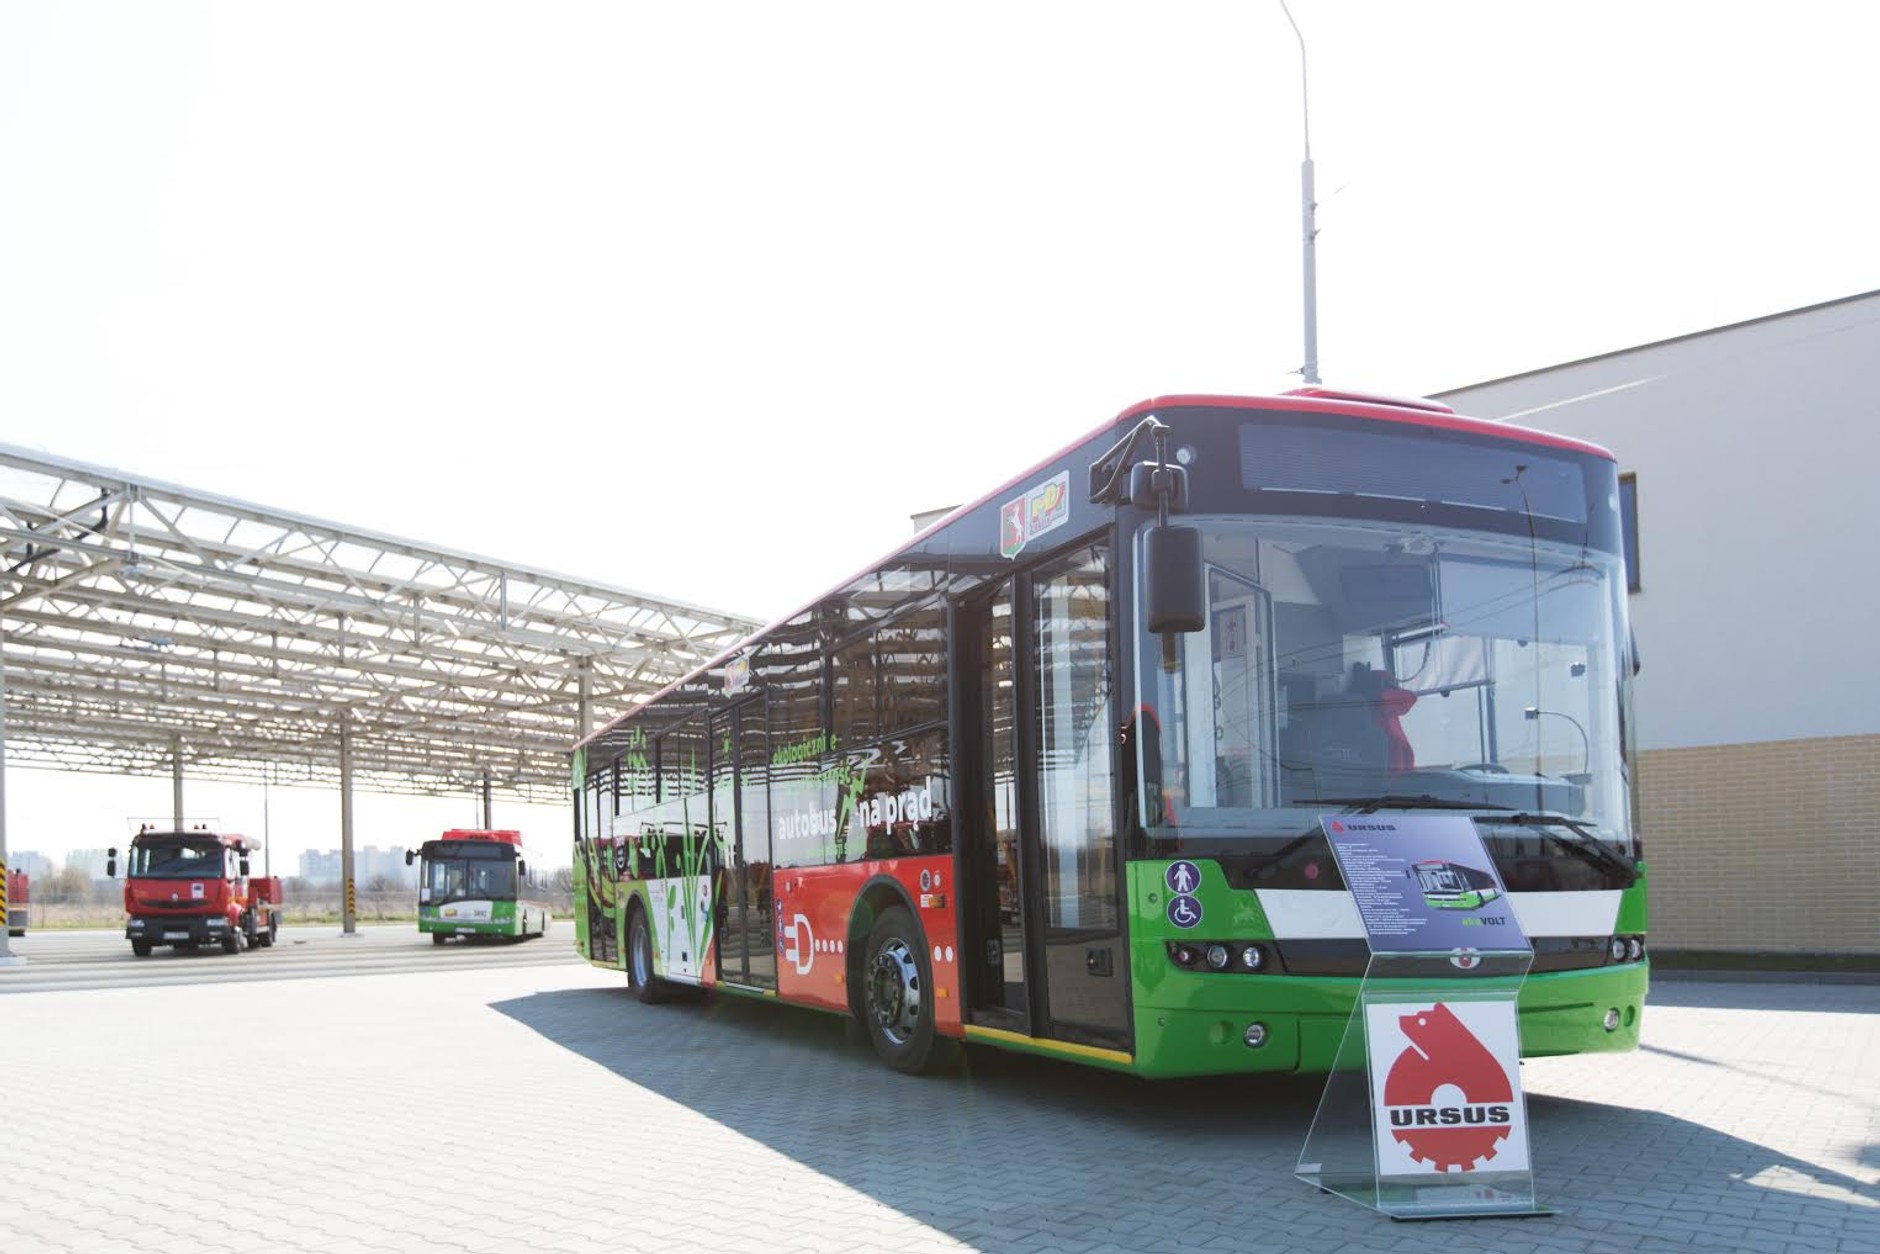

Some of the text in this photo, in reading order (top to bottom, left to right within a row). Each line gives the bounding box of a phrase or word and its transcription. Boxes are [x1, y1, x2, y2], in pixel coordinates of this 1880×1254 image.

[778, 775, 932, 840] autobus na prąd
[1390, 1105, 1510, 1126] URSUS
